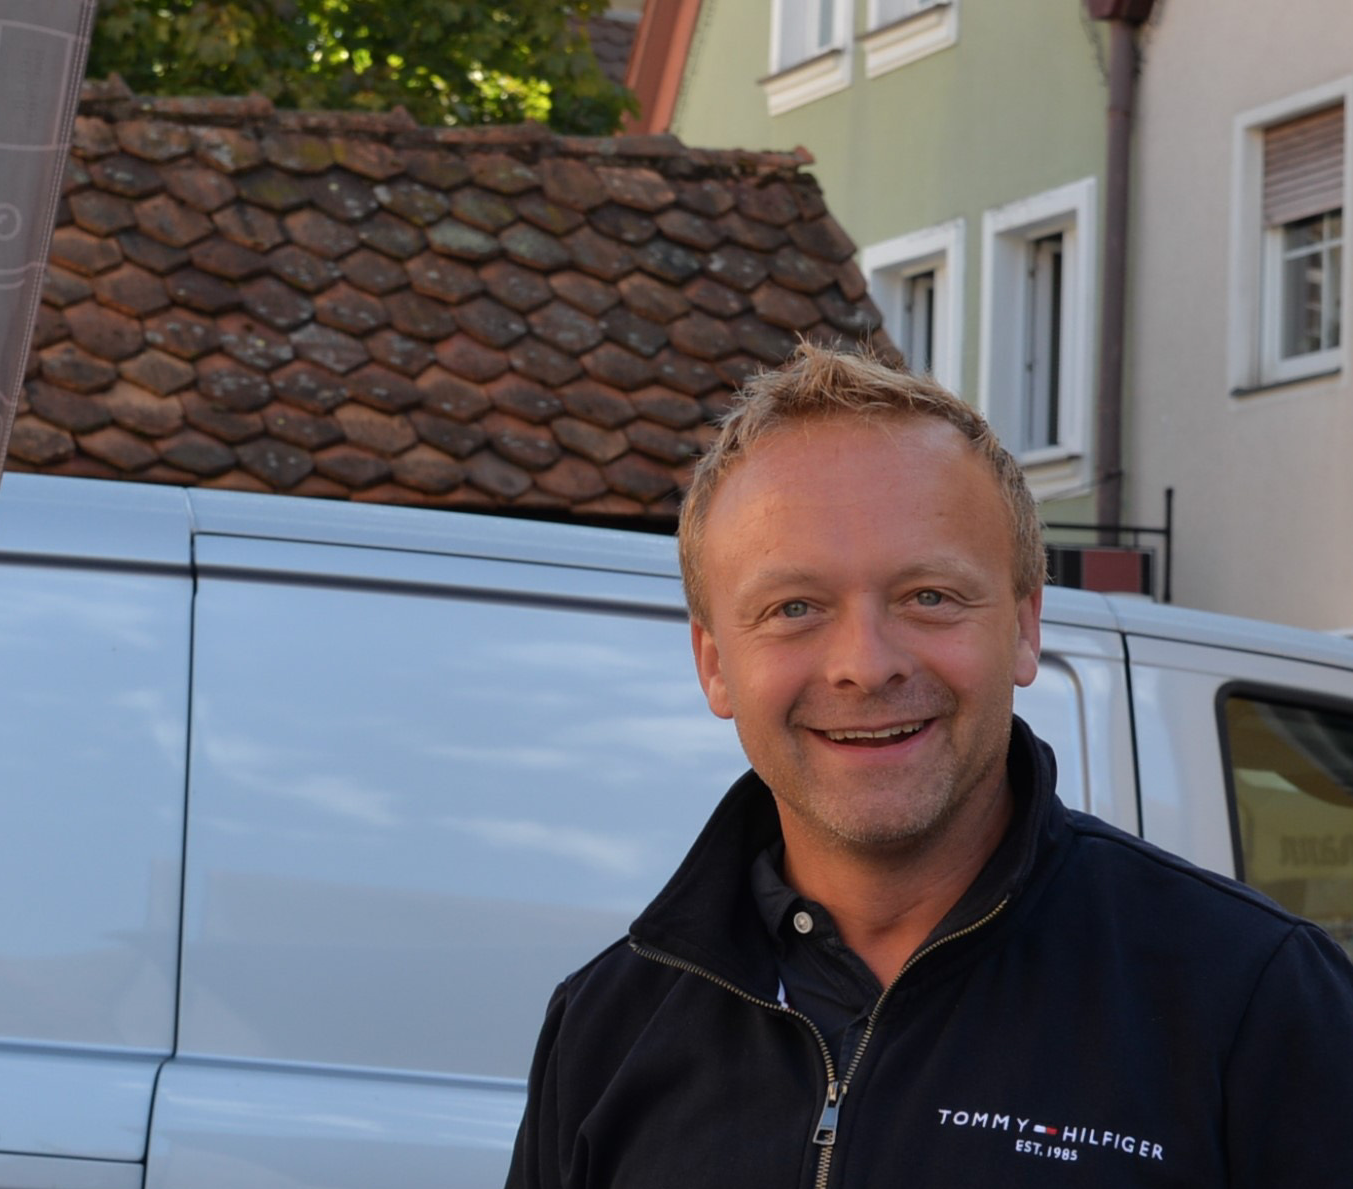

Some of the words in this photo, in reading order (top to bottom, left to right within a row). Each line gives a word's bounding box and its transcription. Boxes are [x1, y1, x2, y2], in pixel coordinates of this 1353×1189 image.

[938, 1108, 1030, 1133] TOMMY
[1062, 1126, 1164, 1161] HILFIGER
[1015, 1139, 1043, 1157] EST.
[1046, 1145, 1078, 1161] 1985
